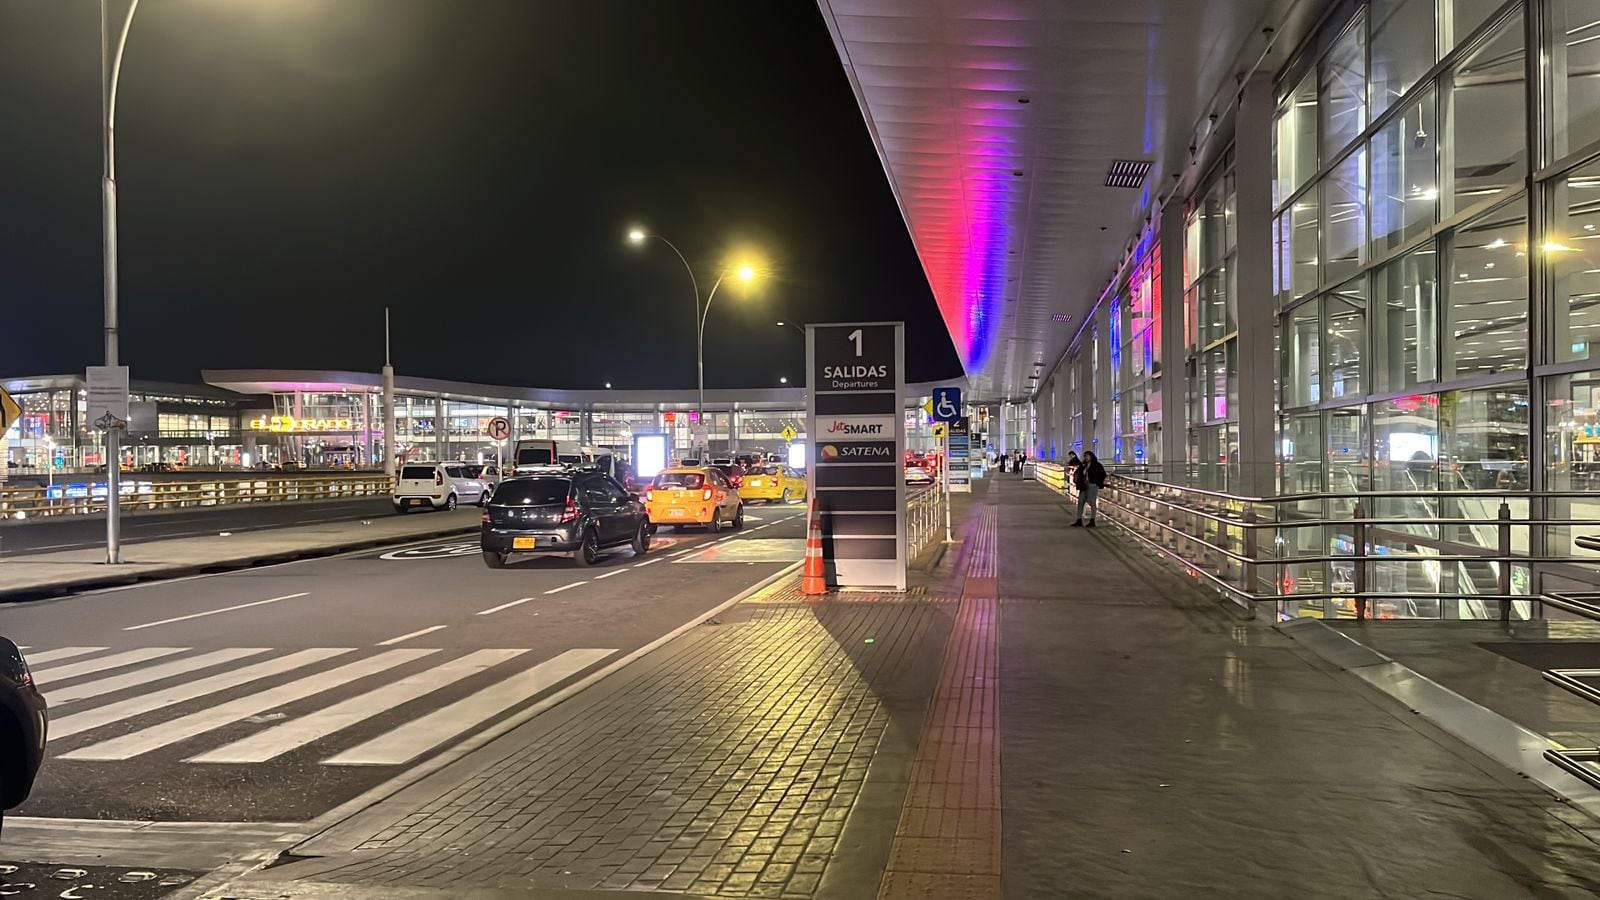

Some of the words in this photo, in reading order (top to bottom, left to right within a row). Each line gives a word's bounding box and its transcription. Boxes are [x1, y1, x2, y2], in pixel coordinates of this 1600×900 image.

[848, 329, 863, 357] 1
[824, 365, 887, 378] SALIDAS
[832, 380, 878, 389] Departures
[495, 420, 506, 437] P
[841, 446, 890, 456] SATENA
